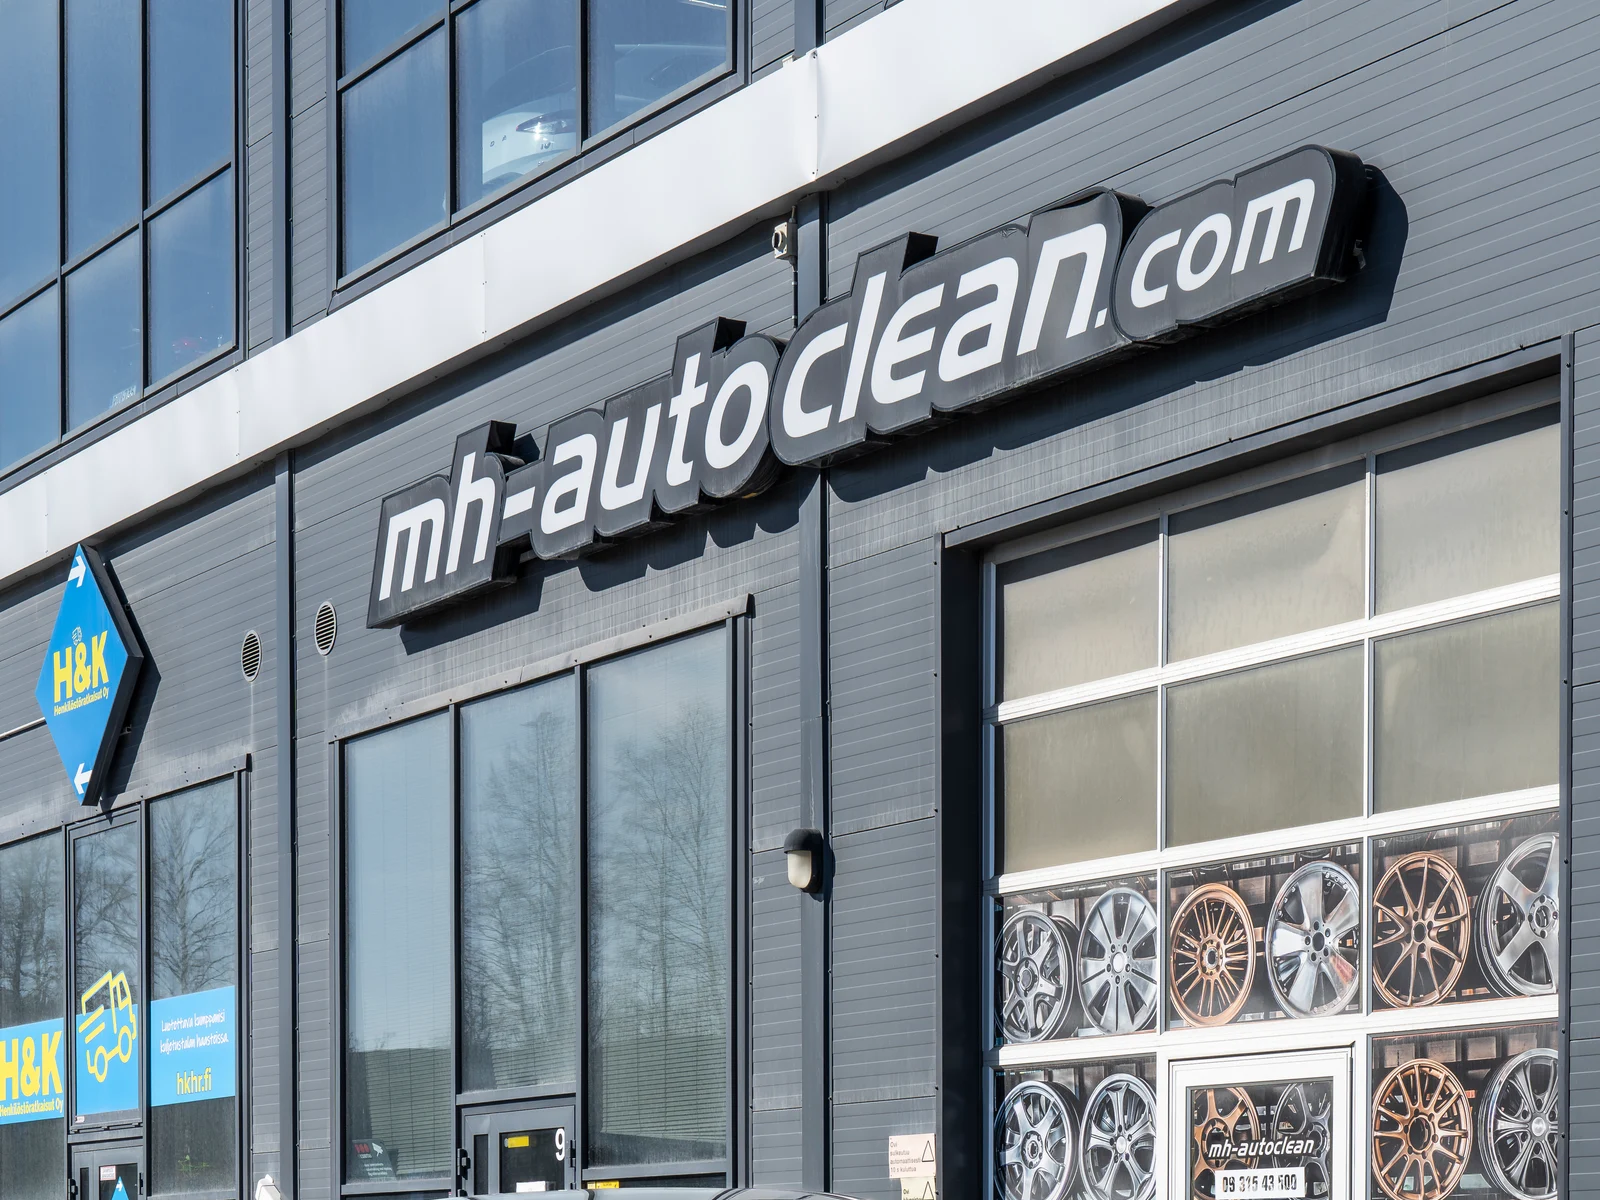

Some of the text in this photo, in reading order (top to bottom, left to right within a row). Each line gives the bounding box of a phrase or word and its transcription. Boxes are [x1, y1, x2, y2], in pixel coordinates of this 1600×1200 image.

[379, 177, 1318, 601] mh-autoclean.com
[53, 630, 109, 703] H&K
[103, 686, 109, 699] Oy
[0, 1031, 63, 1101] H&K
[176, 1067, 212, 1096] hkhr.fi
[55, 1097, 64, 1114] Oy
[555, 1128, 566, 1161] 9
[1208, 1136, 1315, 1158] mh-autoclean
[1222, 1176, 1235, 1192] 09
[1262, 1174, 1274, 1191] 43
